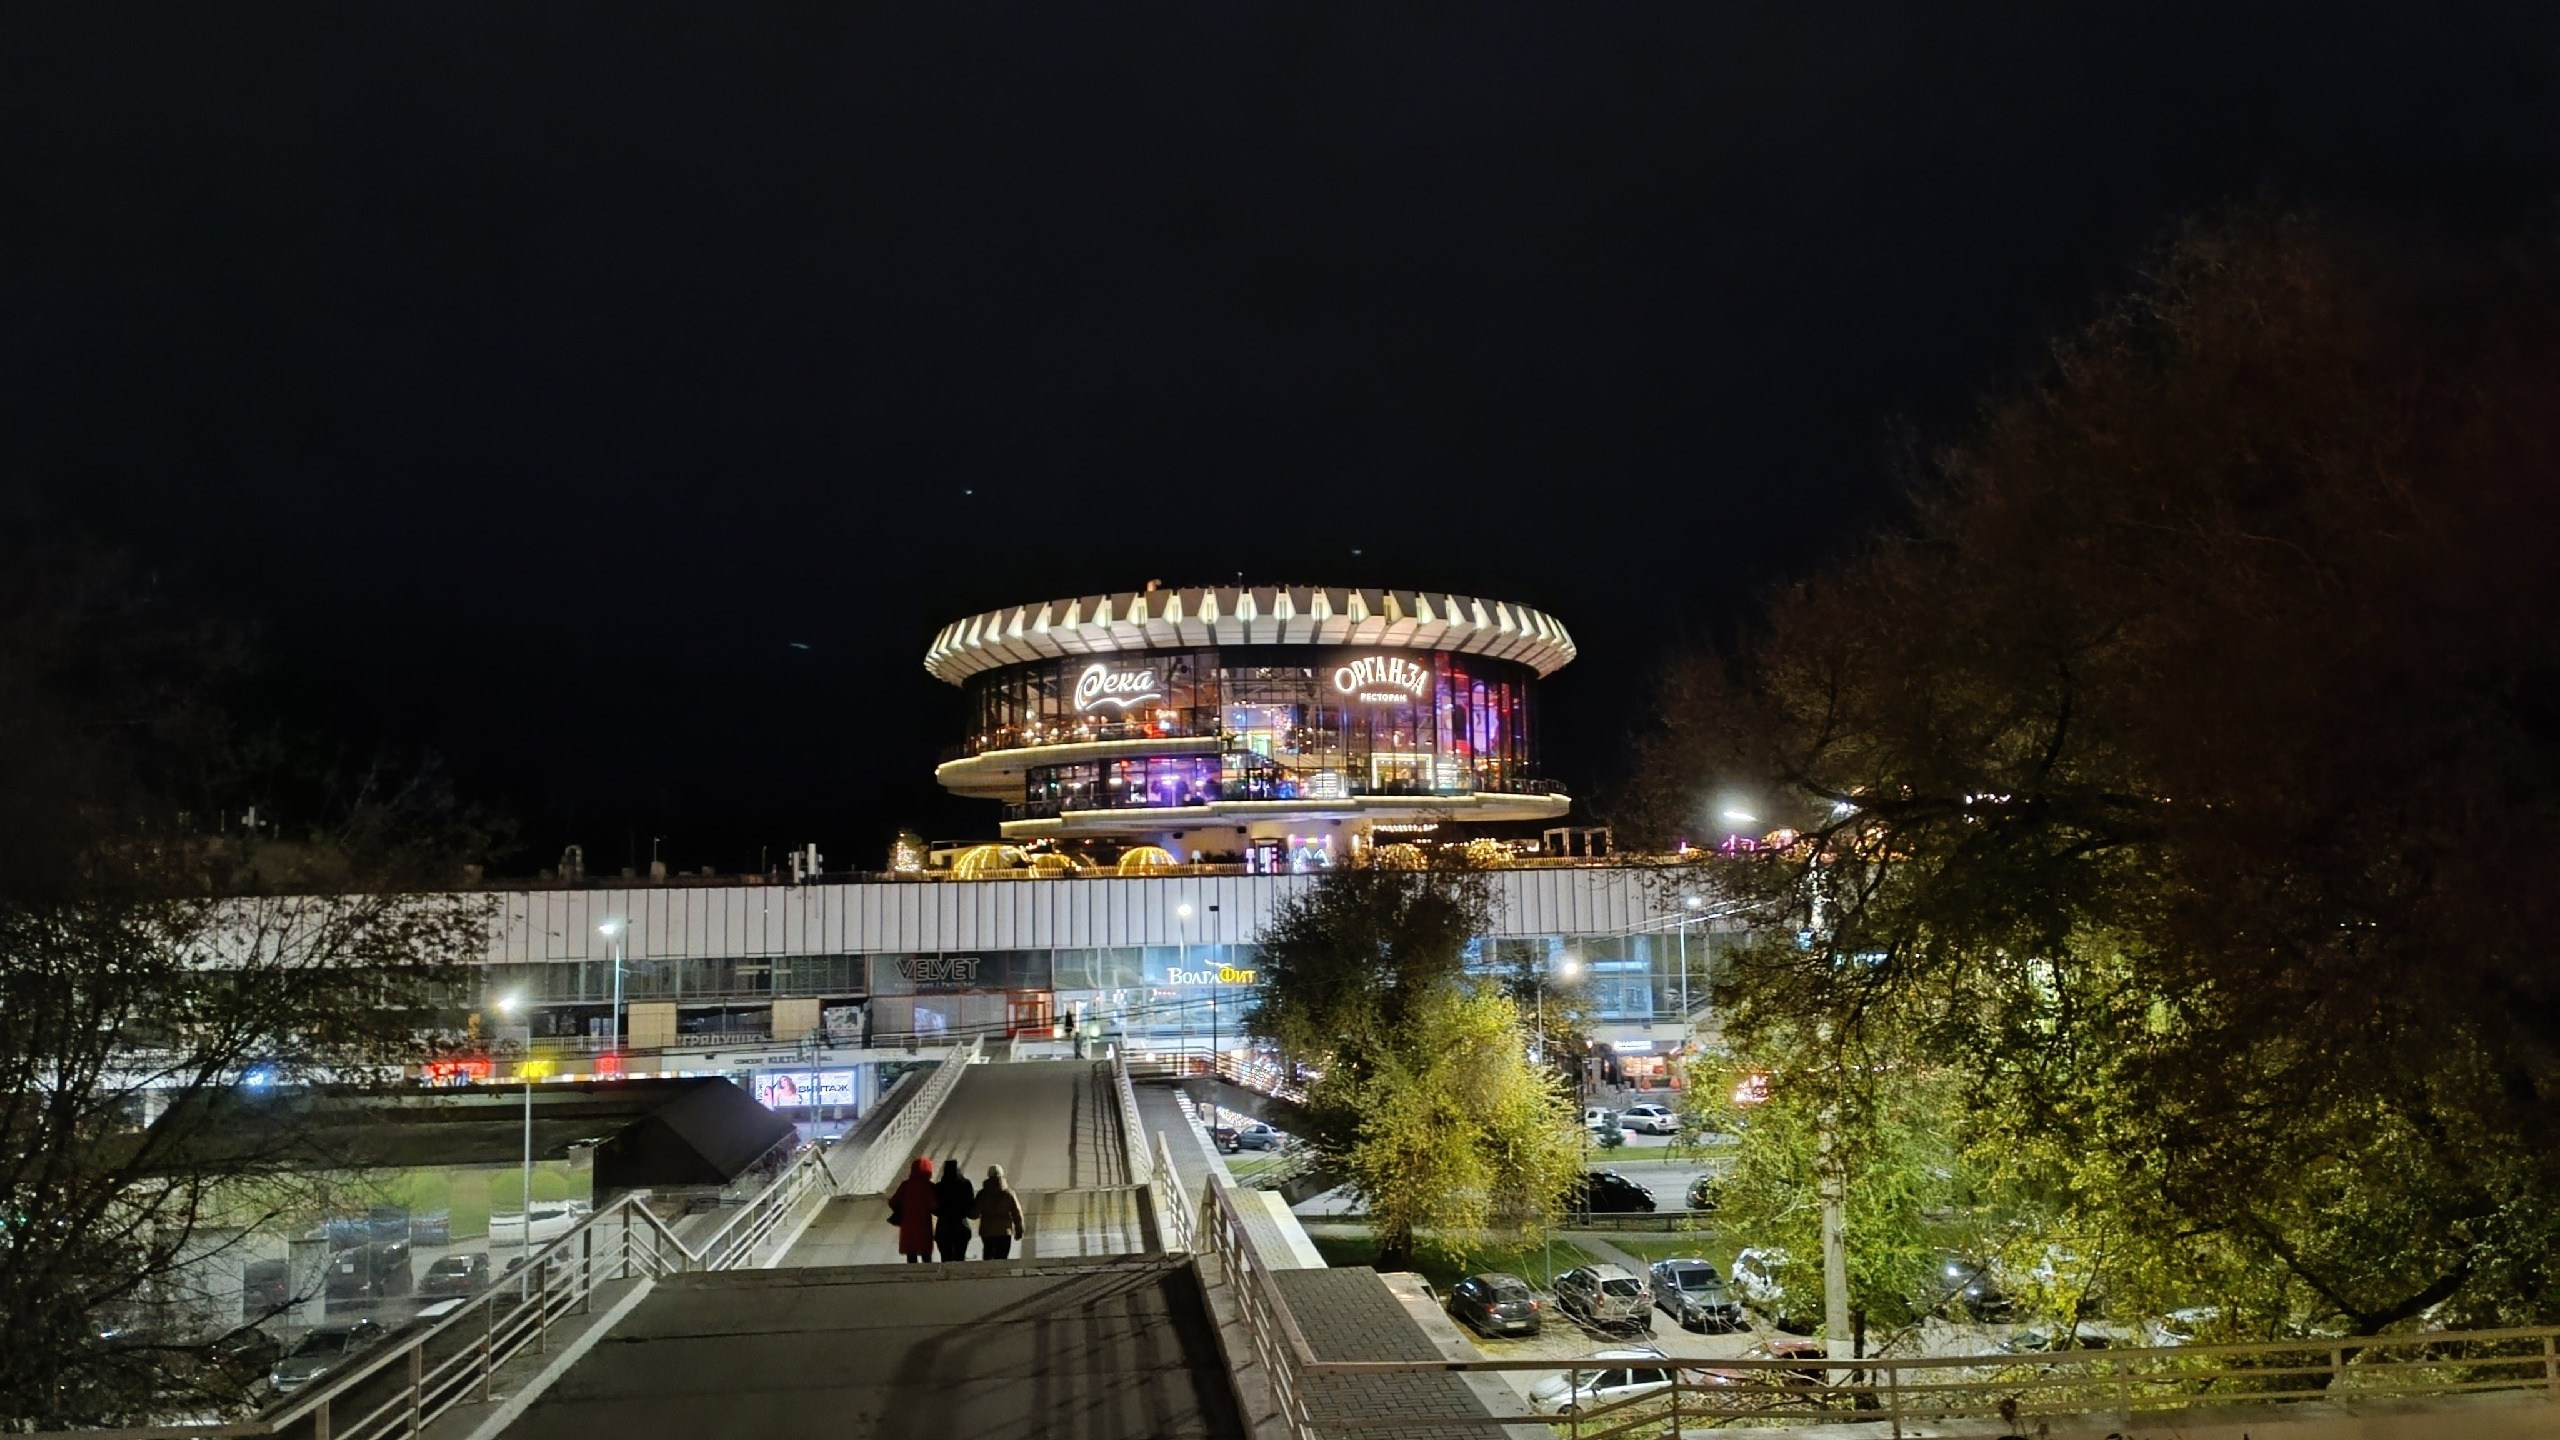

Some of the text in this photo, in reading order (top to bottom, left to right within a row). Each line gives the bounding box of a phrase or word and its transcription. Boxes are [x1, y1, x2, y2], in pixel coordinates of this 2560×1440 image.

[1334, 656, 1429, 697] ОРГАНЗА
[1360, 692, 1408, 702] РЕСТОРАН
[895, 958, 980, 981] VELVET
